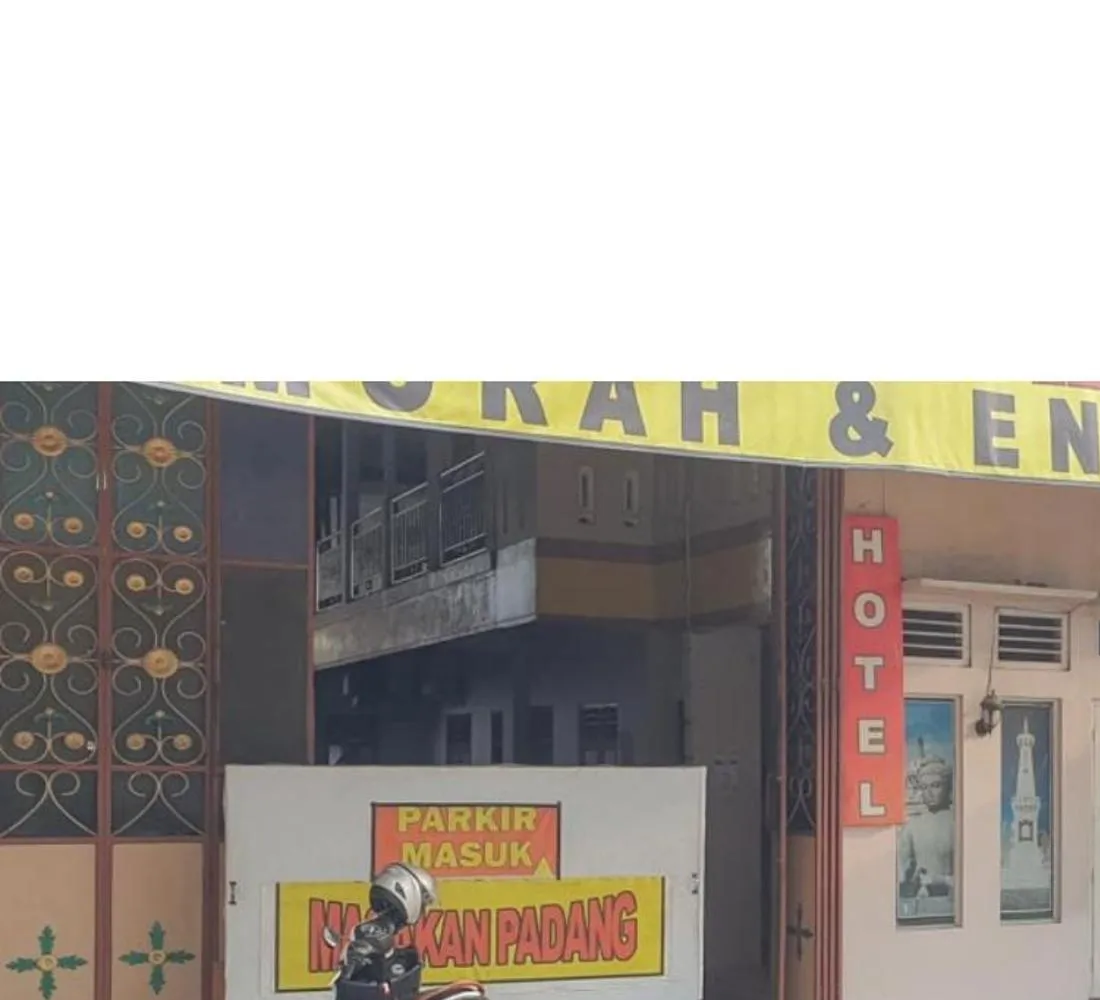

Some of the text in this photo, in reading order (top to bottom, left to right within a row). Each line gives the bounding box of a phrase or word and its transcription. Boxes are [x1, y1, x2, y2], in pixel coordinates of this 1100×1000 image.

[829, 381, 894, 457] &
[852, 528, 886, 817] HOTEL
[398, 806, 537, 833] PARKIR
[401, 841, 534, 870] MASUK
[498, 890, 638, 966] PADANG
